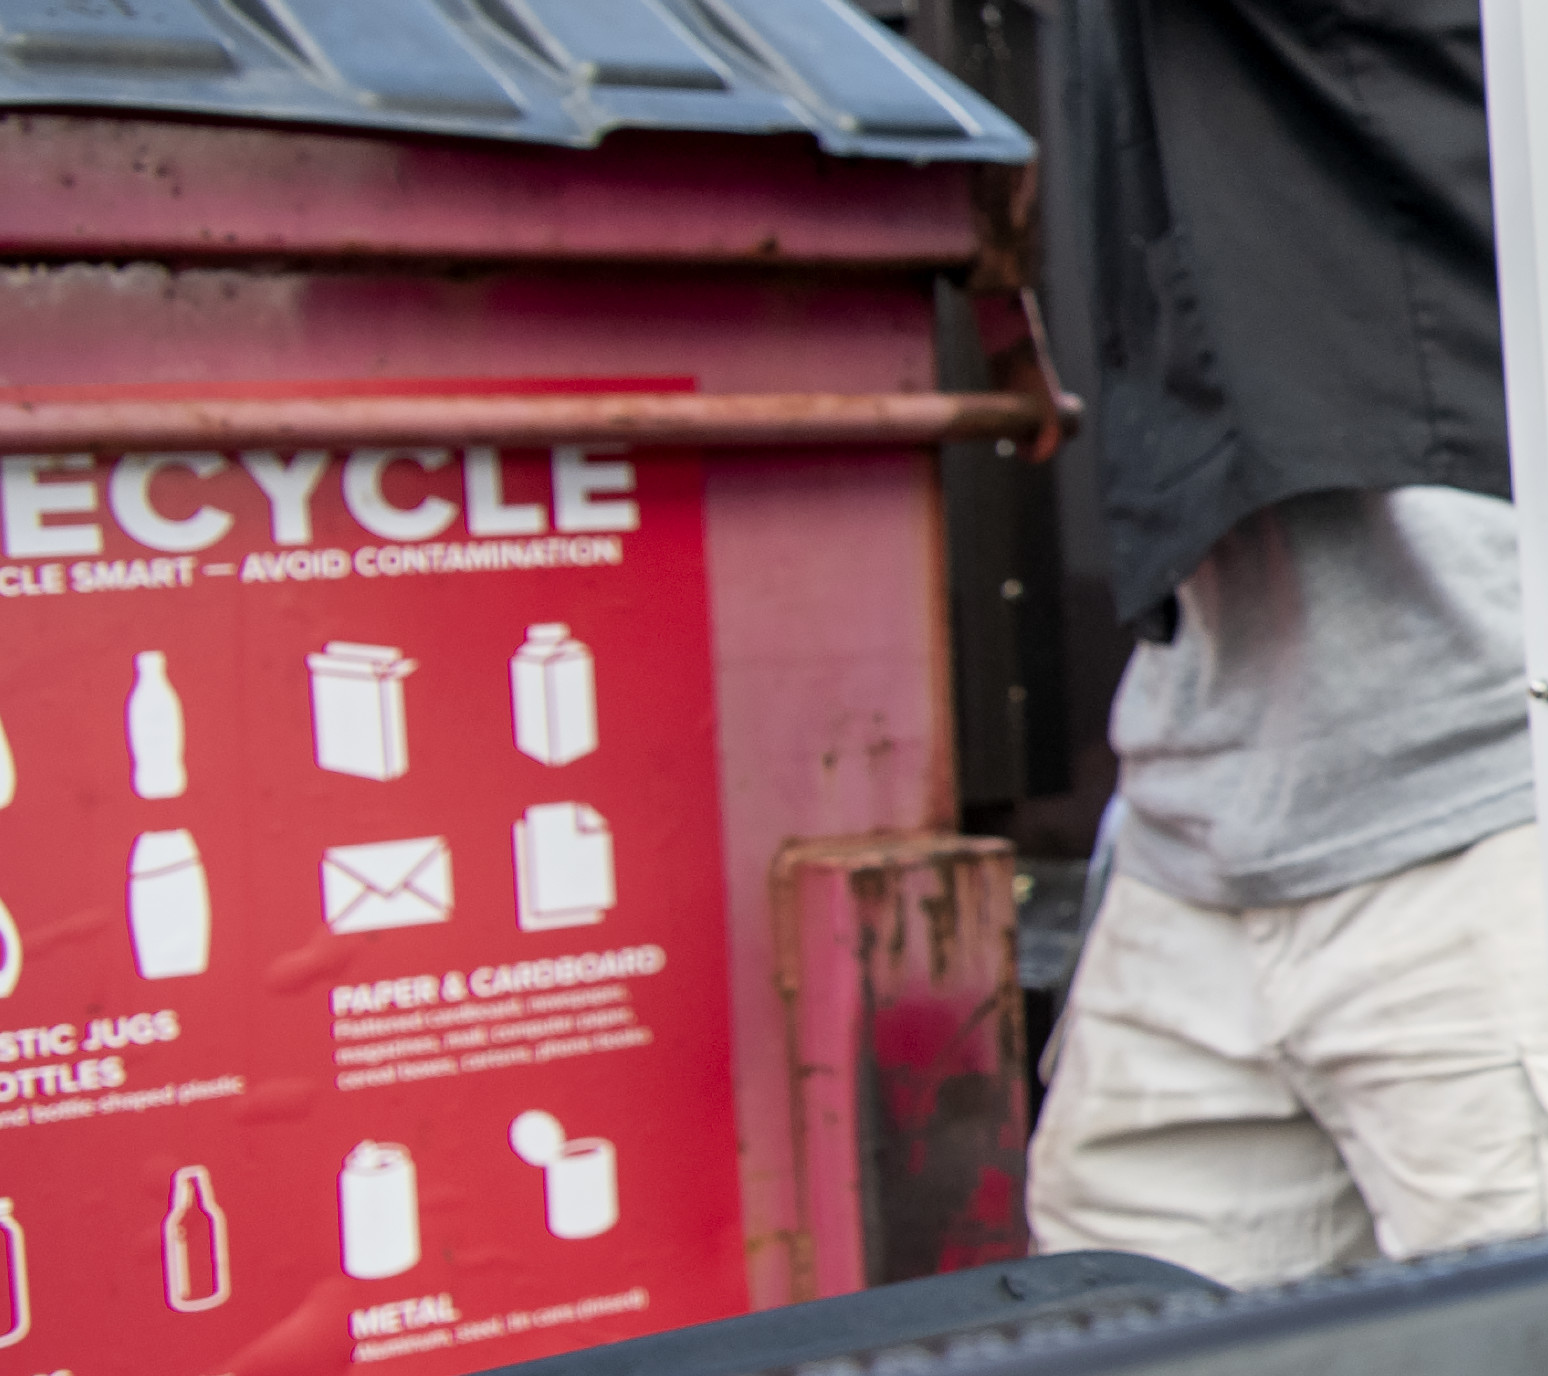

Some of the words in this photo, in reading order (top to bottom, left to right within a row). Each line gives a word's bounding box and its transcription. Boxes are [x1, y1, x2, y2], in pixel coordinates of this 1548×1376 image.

[2, 443, 641, 559] ECYCLE
[72, 556, 195, 593] SMART
[240, 547, 351, 584] AVOID
[354, 535, 623, 578] CONTAMINATION
[330, 975, 440, 1016] PAPER
[440, 970, 468, 1002] &
[468, 944, 667, 998] CARDBOARD
[81, 1009, 182, 1053] JUGS
[348, 1291, 463, 1341] METAL
